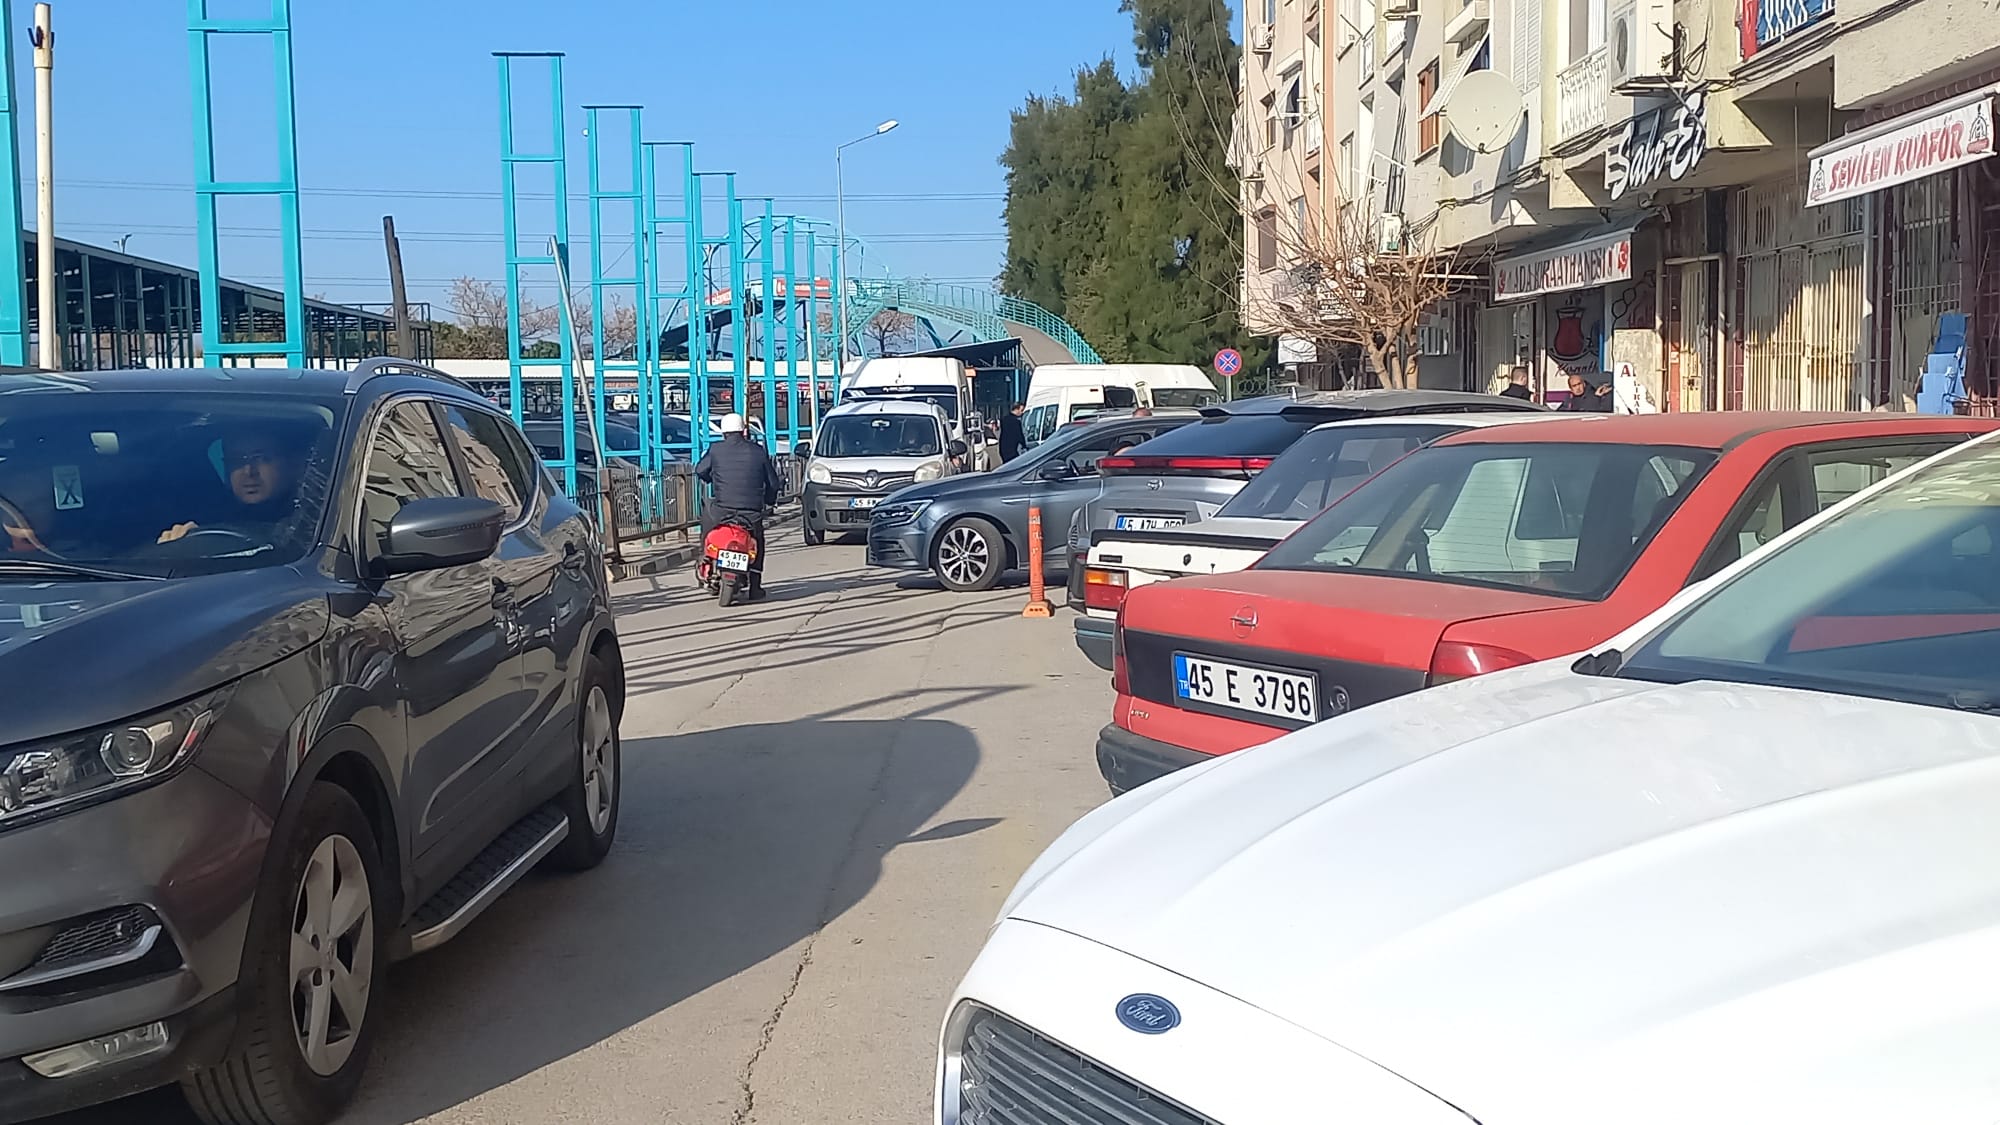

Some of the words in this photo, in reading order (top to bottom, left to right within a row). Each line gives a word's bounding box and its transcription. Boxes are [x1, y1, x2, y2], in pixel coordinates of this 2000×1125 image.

[1828, 144, 1893, 192] SEVİLEN
[1894, 115, 1964, 177] KUAFÖR
[720, 551, 730, 559] 45
[1189, 663, 1214, 698] 45
[1225, 669, 1241, 703] E
[1252, 674, 1312, 716] 3796
[1125, 1000, 1164, 1026] Ford
